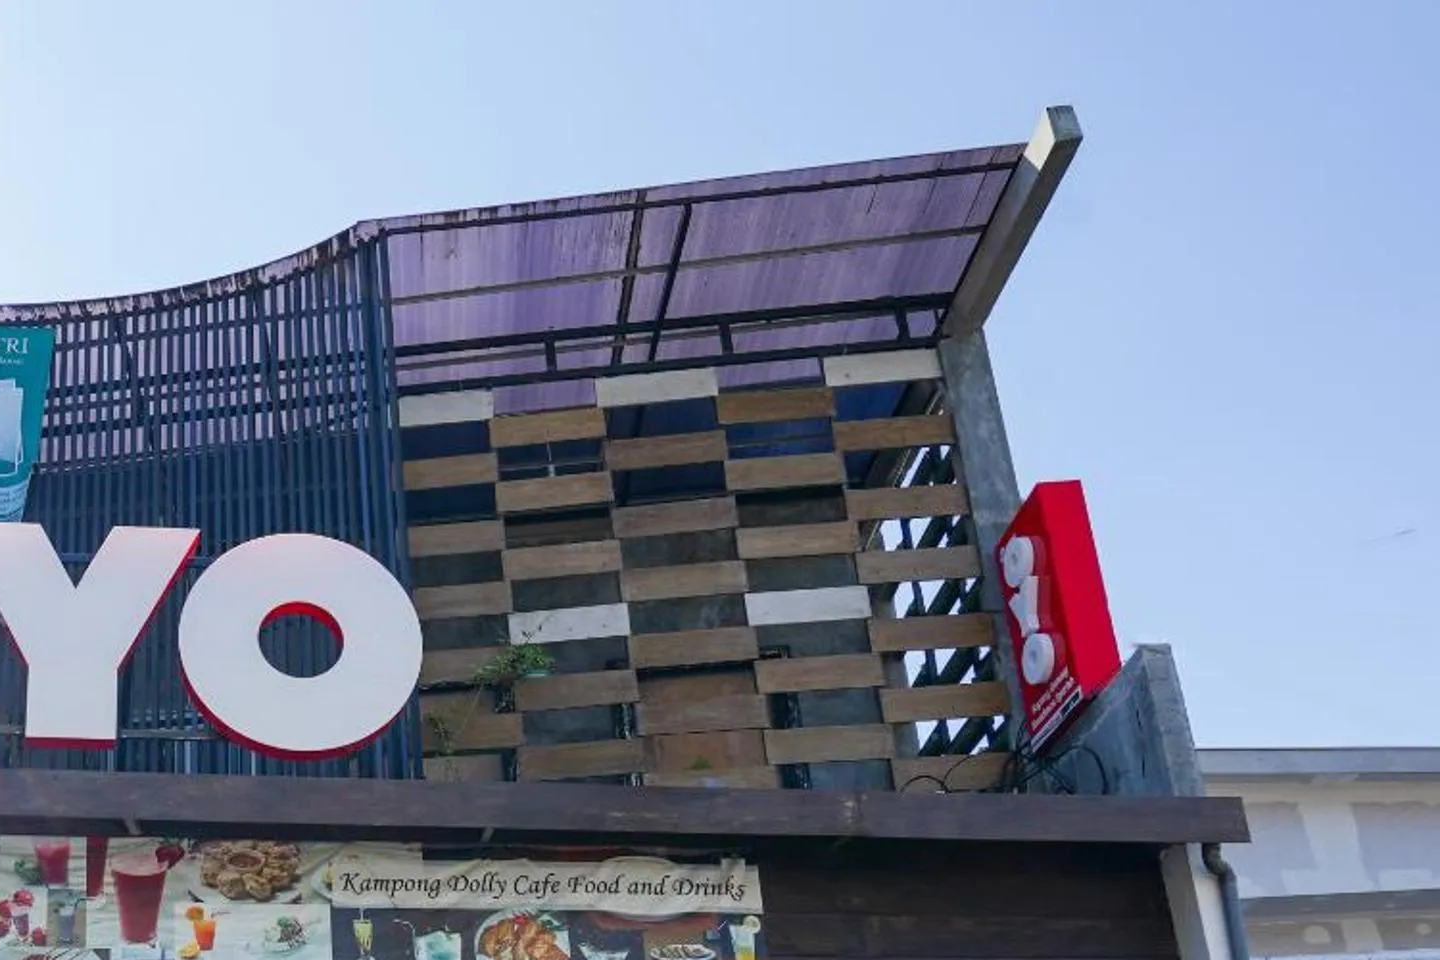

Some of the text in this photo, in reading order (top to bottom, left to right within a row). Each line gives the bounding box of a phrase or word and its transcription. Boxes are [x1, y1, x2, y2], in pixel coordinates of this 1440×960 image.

[1000, 534, 1056, 686] OYO
[339, 873, 747, 900] Kampong Dolly Cafe Food and Drinks
